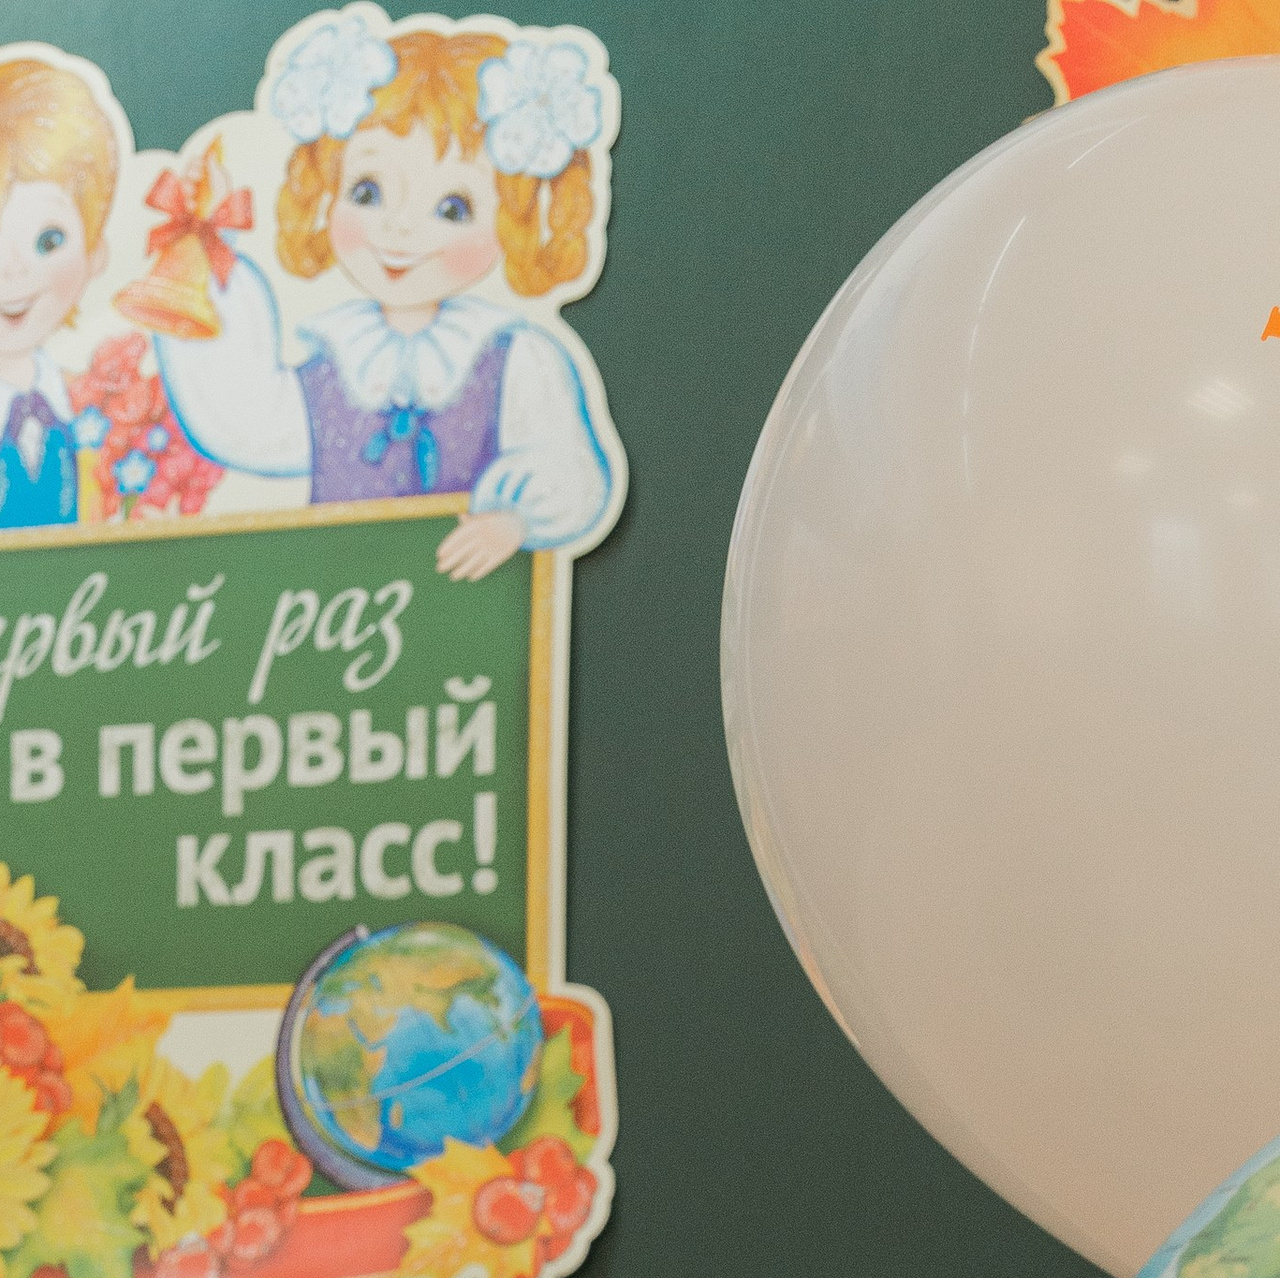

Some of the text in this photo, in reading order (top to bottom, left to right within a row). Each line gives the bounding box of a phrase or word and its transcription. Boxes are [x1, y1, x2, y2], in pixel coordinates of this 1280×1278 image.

[246, 577, 415, 704] раз
[9, 675, 497, 817] в первый
[176, 791, 498, 908] класс!
